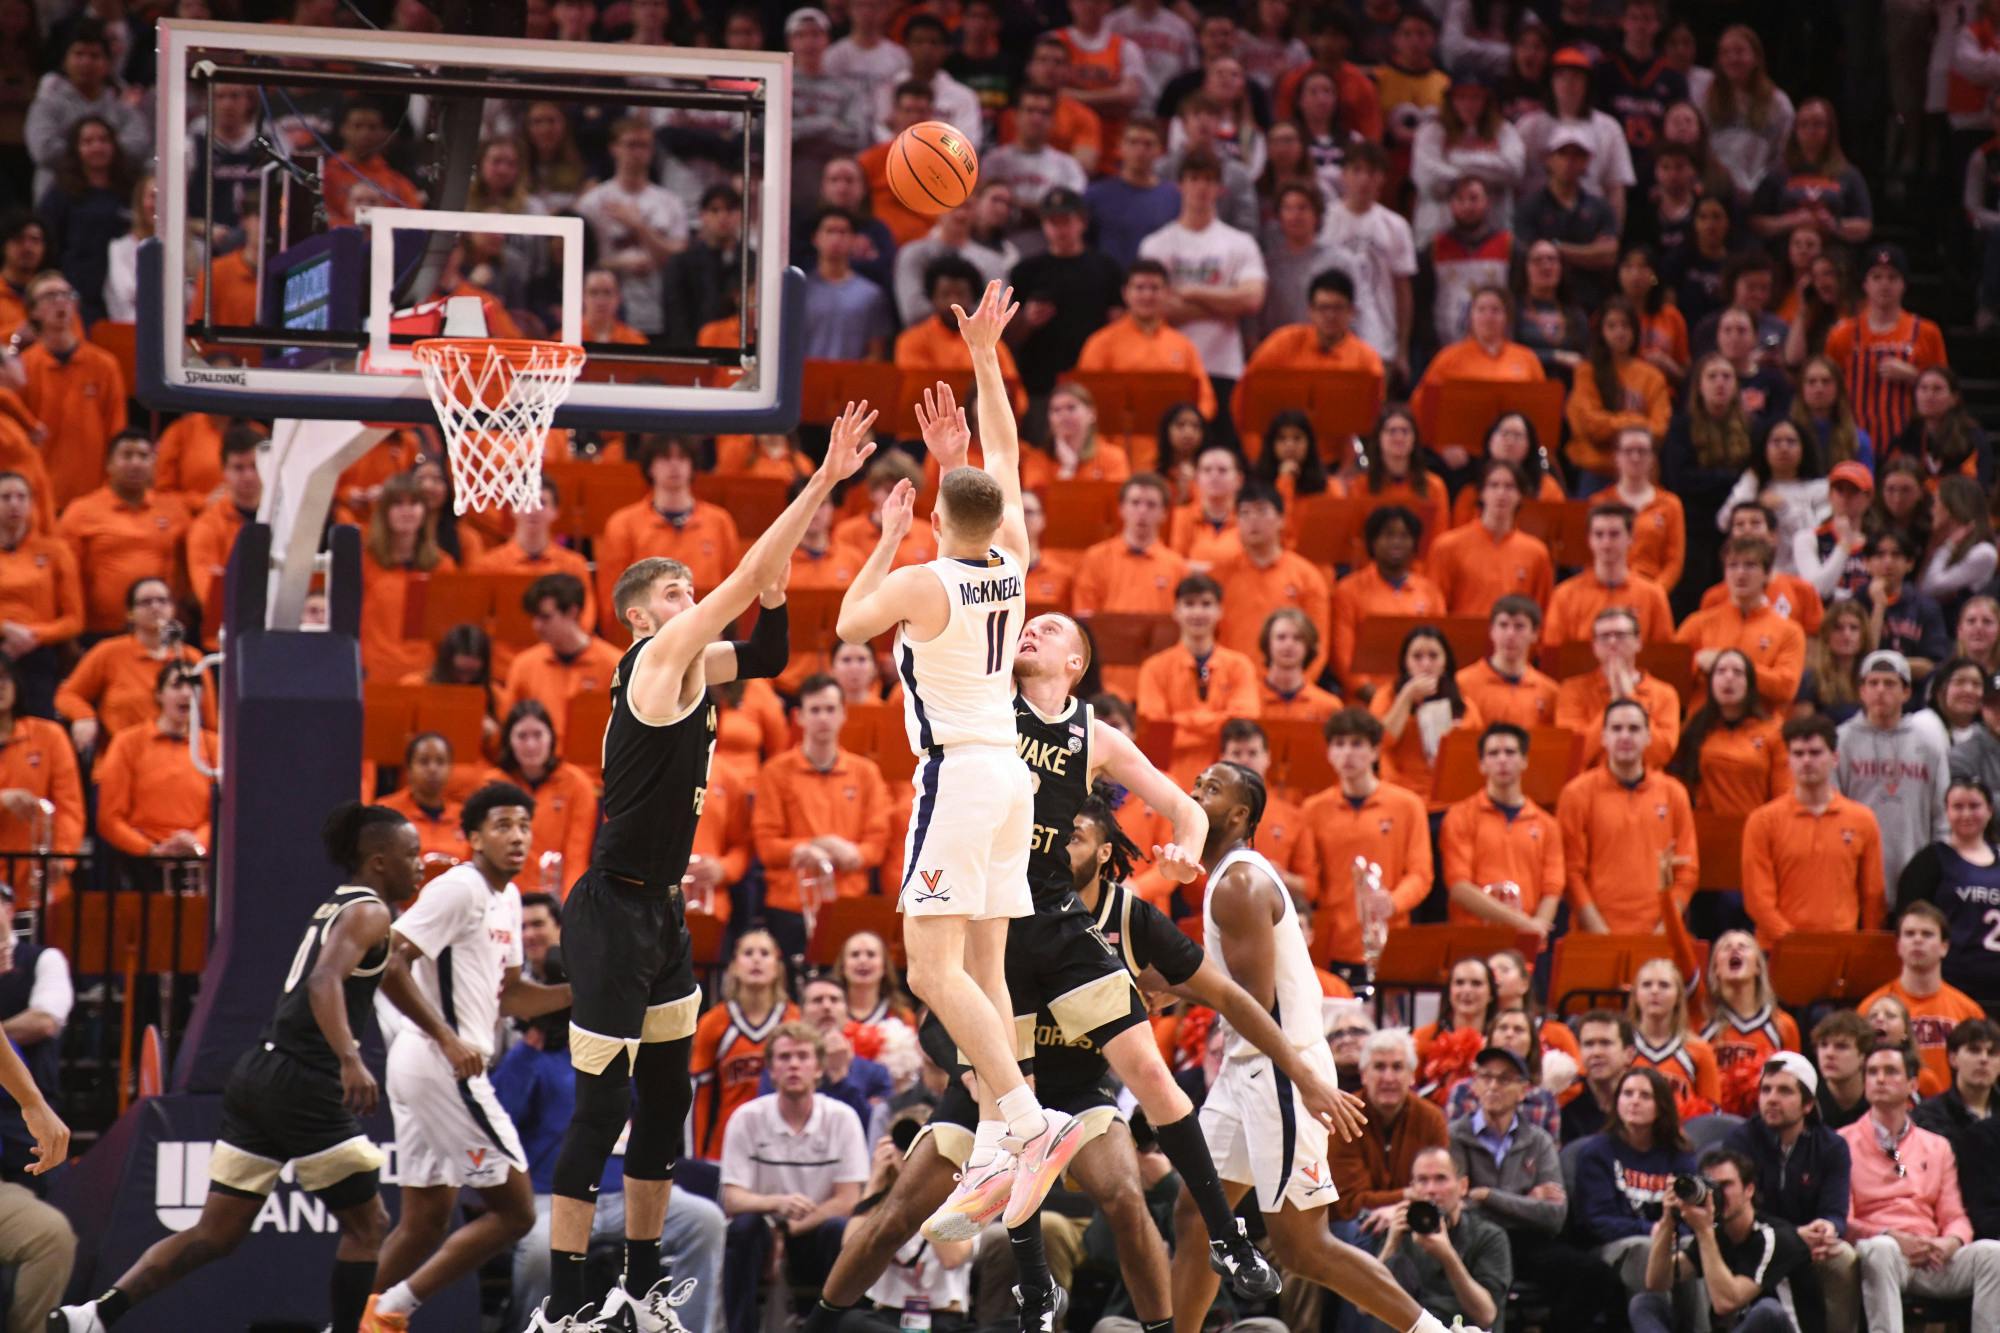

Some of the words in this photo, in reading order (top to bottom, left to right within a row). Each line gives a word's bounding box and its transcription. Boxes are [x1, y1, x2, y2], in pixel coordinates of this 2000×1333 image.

[940, 134, 975, 176] ELITE
[184, 371, 247, 386] SPALDING
[986, 609, 1010, 676] 11
